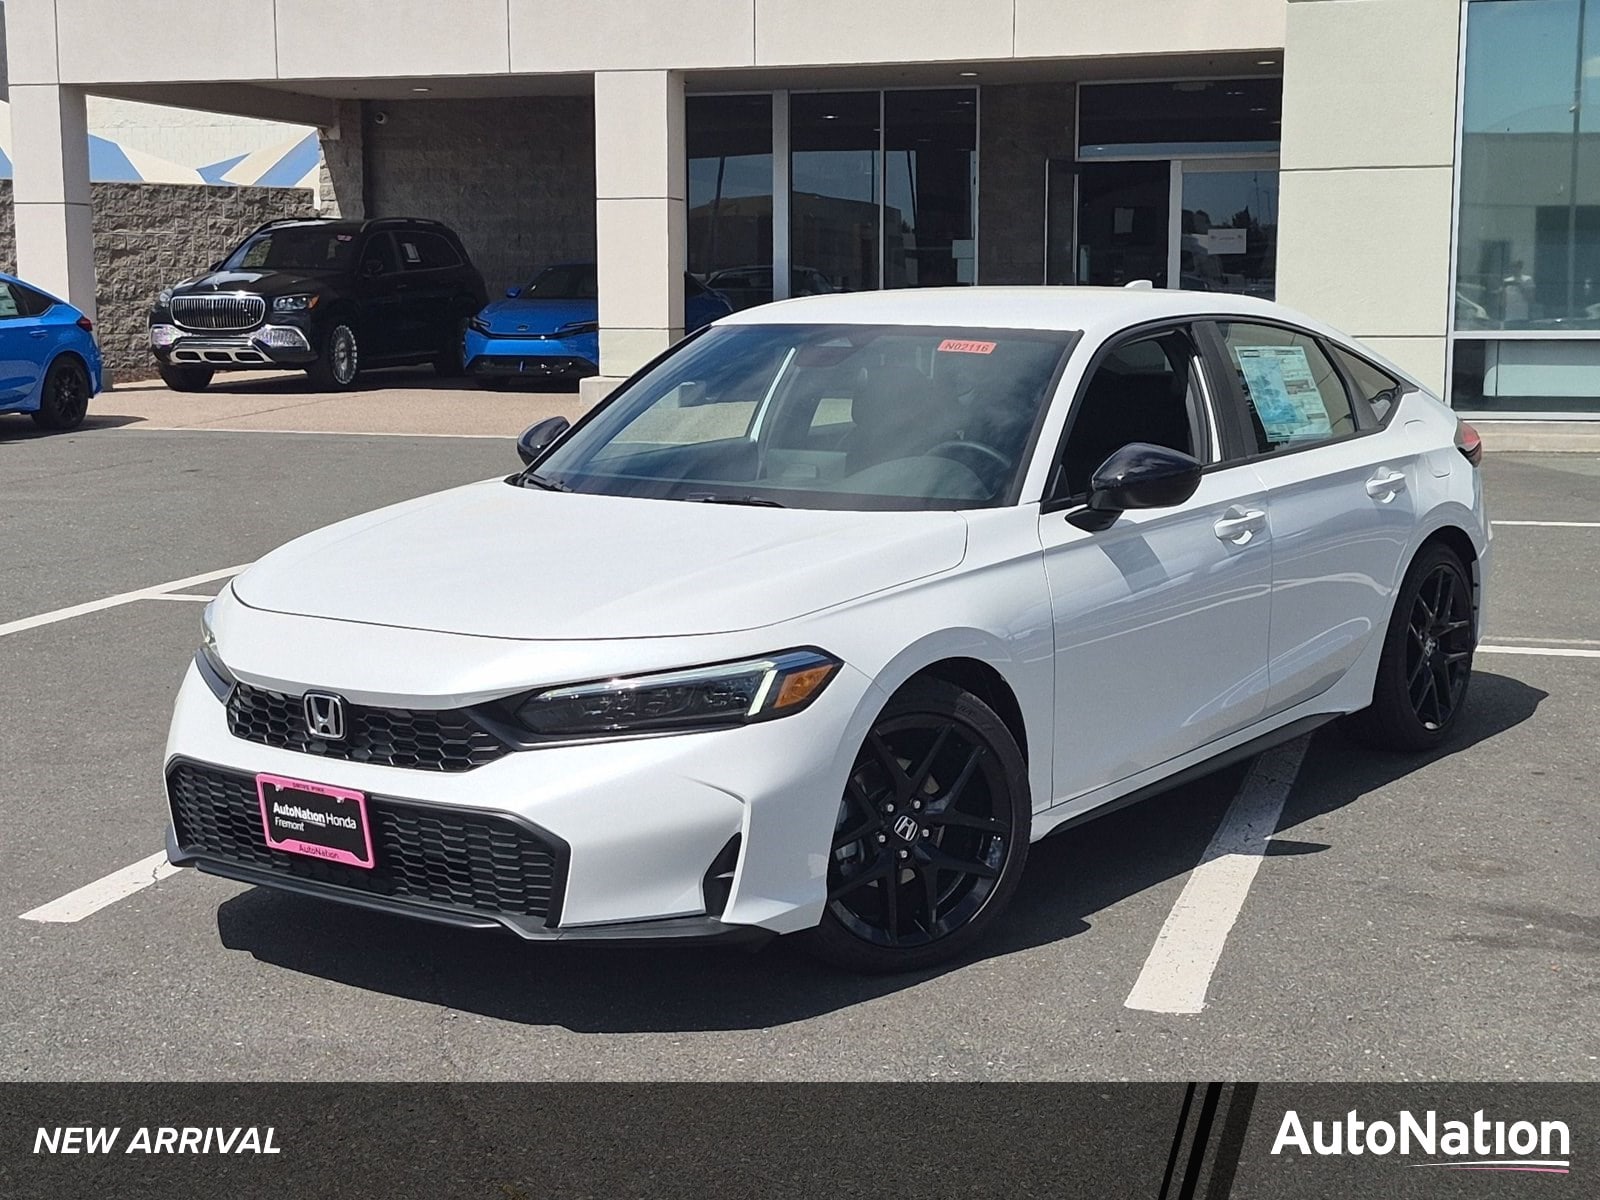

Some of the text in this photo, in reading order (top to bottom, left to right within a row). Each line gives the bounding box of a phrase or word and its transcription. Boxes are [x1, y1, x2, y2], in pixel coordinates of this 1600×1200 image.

[944, 342, 989, 352] N02116
[273, 802, 357, 829] AutoNation Honda
[275, 817, 305, 831] Fremont
[299, 844, 339, 859] AutoNation
